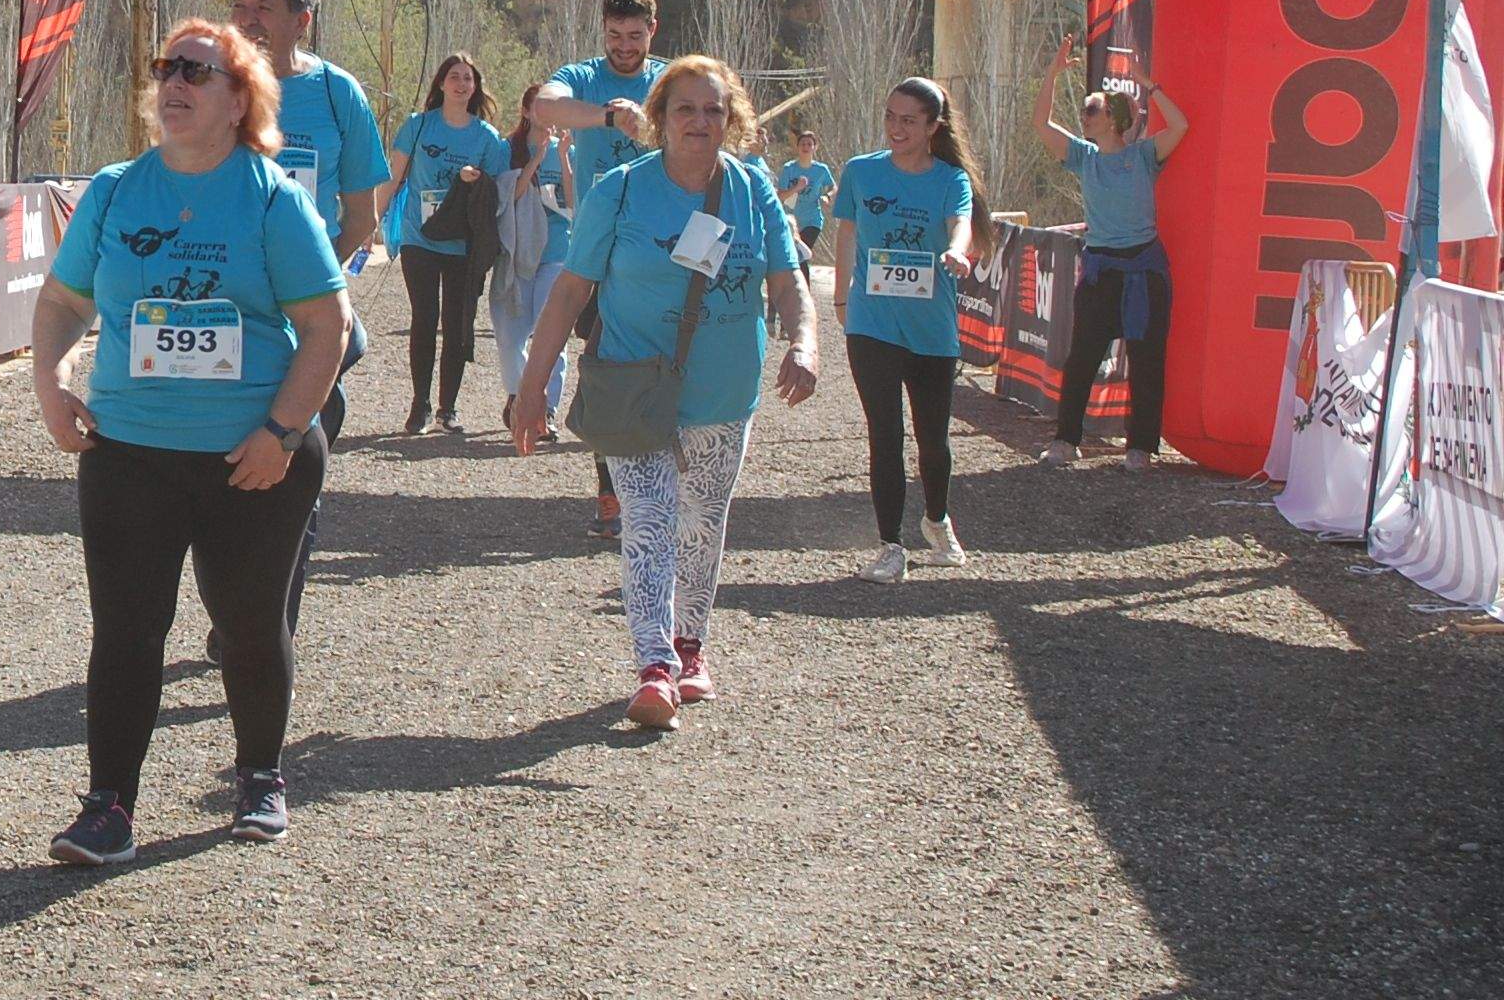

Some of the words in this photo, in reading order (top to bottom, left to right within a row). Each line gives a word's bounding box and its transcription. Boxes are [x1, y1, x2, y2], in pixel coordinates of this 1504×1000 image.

[173, 238, 227, 252] Carrera
[167, 250, 228, 264] solidaria
[882, 266, 920, 283] 790
[156, 328, 218, 353] 593
